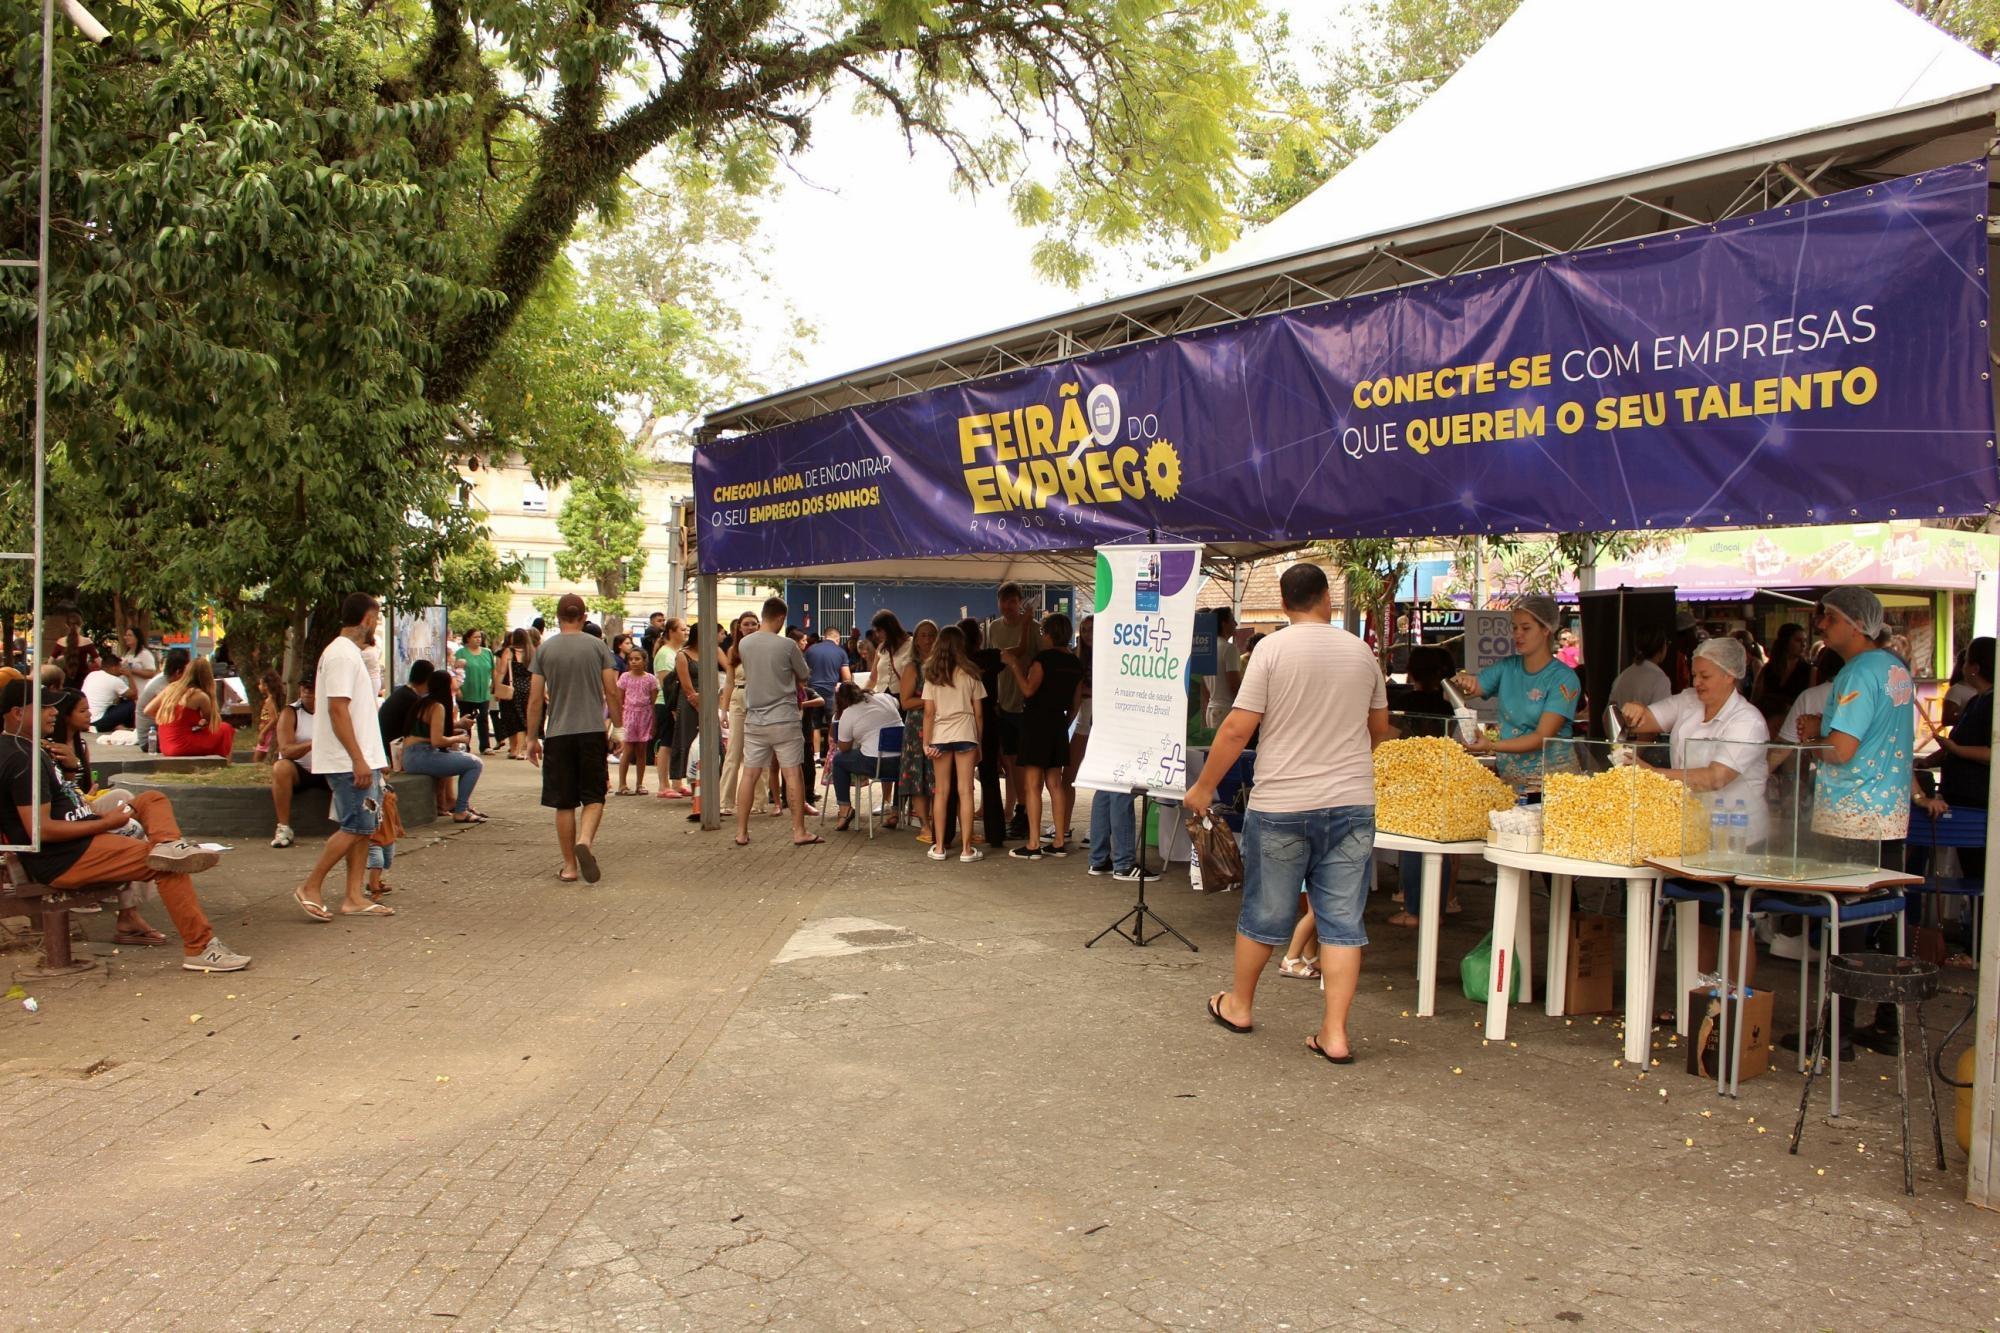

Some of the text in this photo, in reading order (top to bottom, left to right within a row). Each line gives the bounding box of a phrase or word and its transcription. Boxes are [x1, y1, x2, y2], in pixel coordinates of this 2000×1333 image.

[1353, 304, 1876, 409] CONECTE-SE COM EMPRESAS
[1128, 414, 1158, 440] DO
[1342, 366, 1878, 459] QUE QUEREM O SEU TALENTO
[713, 455, 892, 503] CHEGOU A HORA DE ENCONTRAR
[964, 438, 1182, 514] EMPREGO
[712, 486, 880, 527] O SEU EMPREGO DOS SONHOS!
[970, 511, 1100, 532] RIO DO SUL
[1120, 647, 1179, 680] saúde
